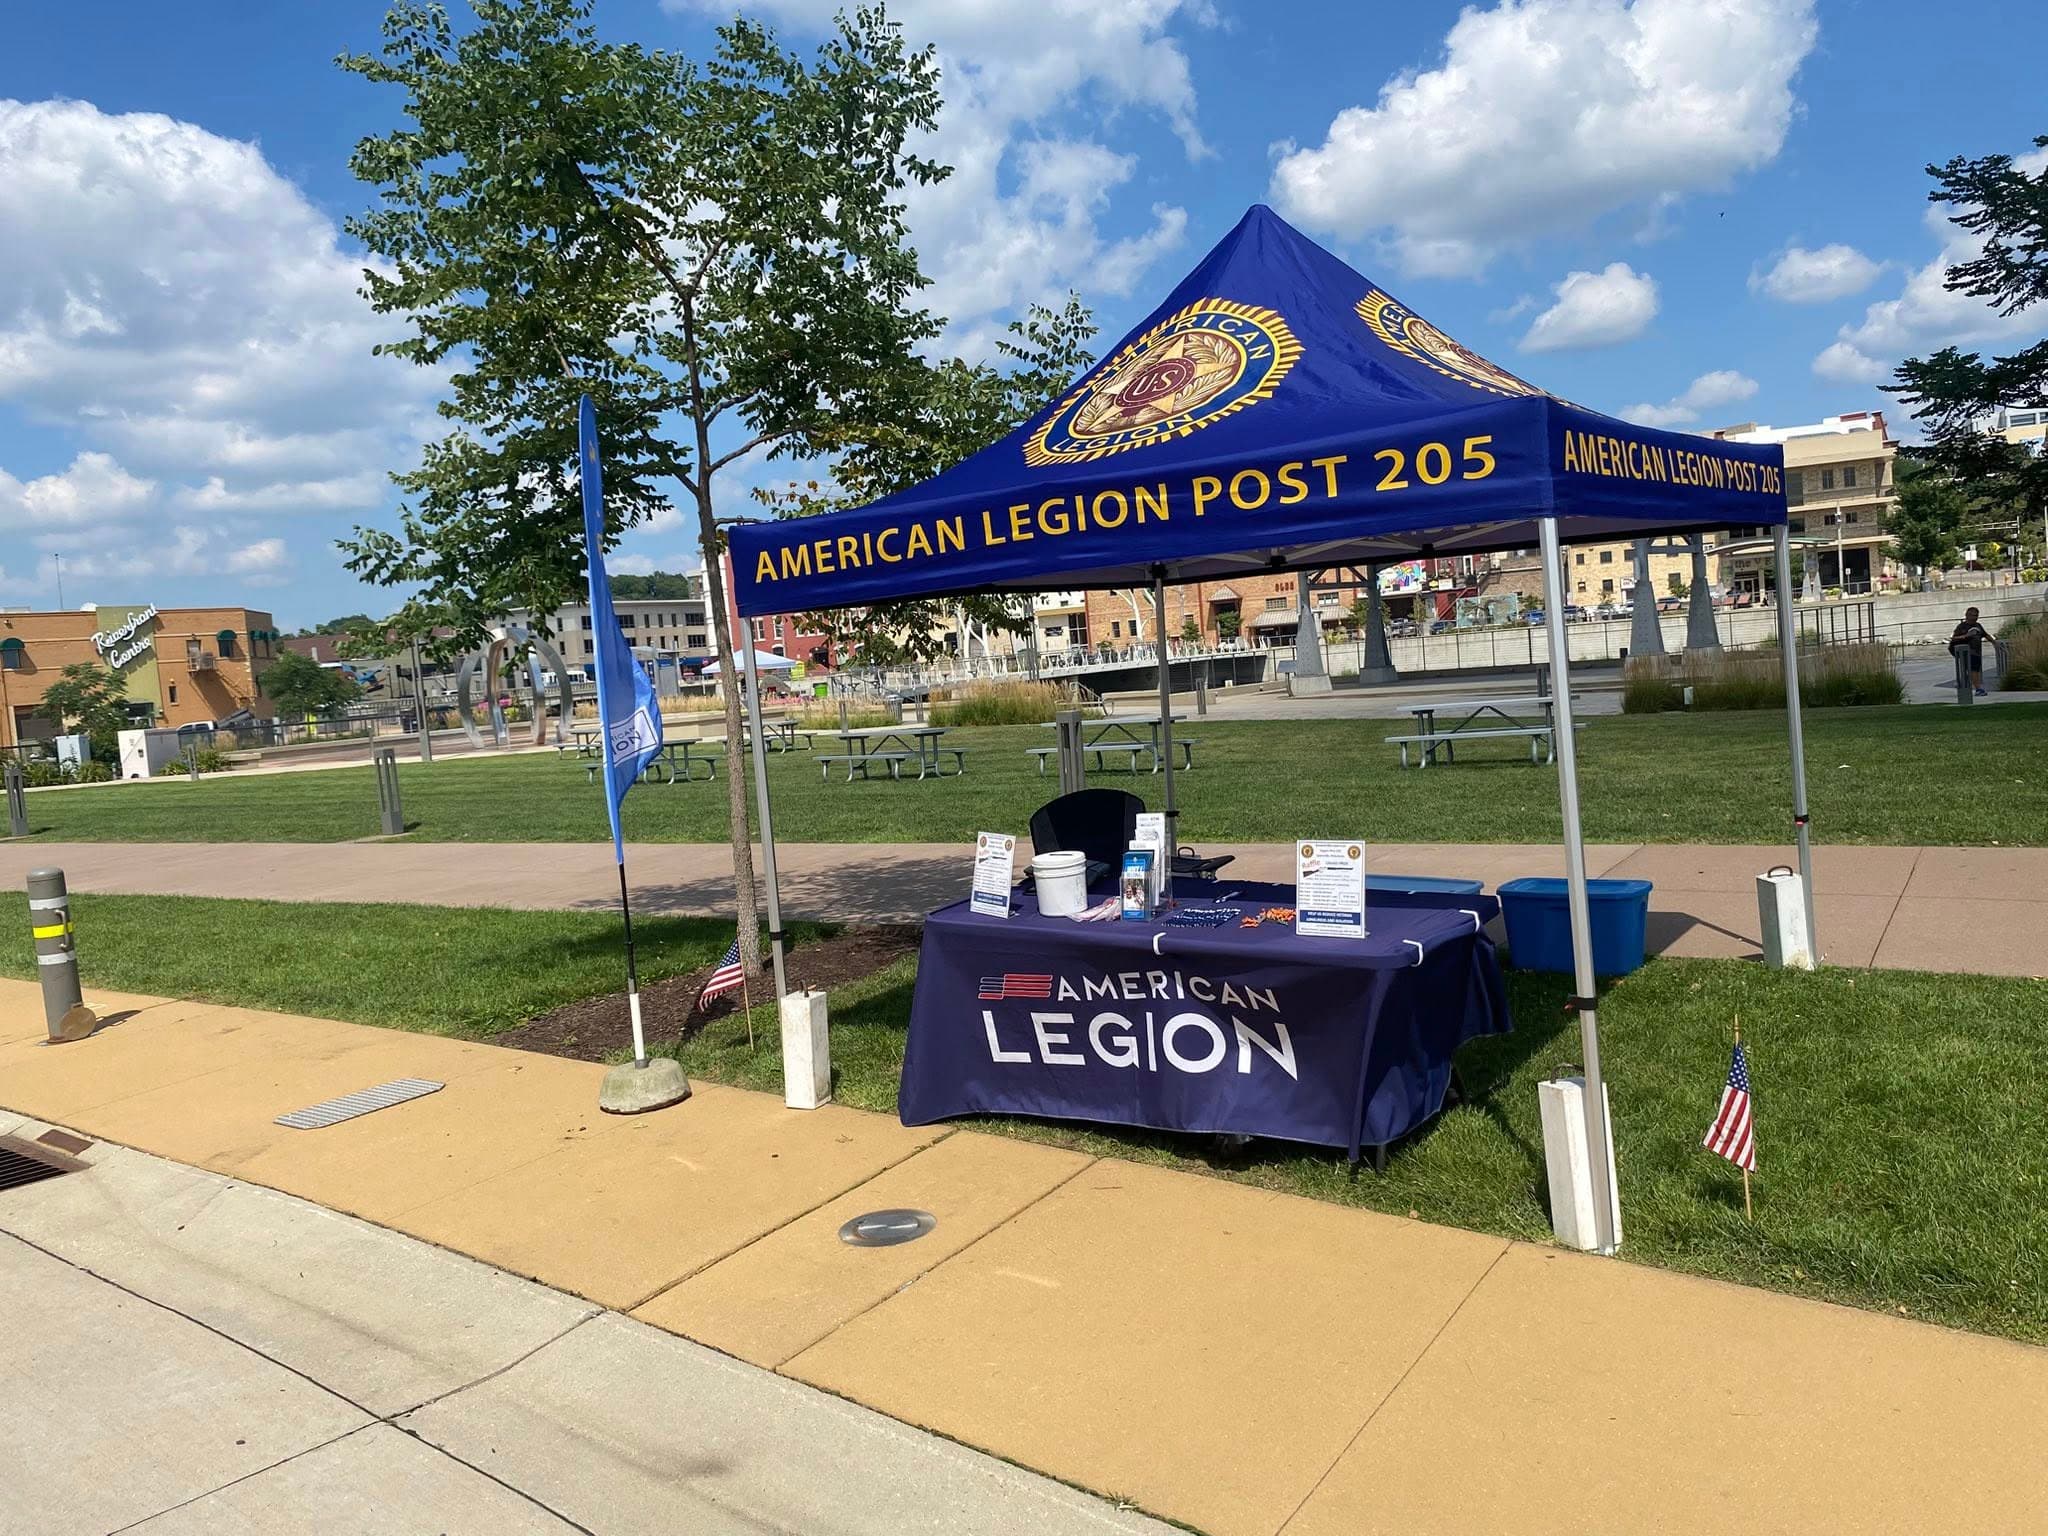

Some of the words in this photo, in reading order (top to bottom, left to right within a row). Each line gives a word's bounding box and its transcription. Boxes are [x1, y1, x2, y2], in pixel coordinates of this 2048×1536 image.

[1052, 414, 1193, 453] LEGION
[1564, 430, 1667, 482] AMERICAN
[1668, 448, 1724, 489] LEGION
[1725, 459, 1757, 492] POST
[1759, 465, 1781, 495] 205
[755, 516, 966, 583] AMERICAN
[982, 483, 1170, 546] LEGION
[1191, 455, 1348, 516] POST
[1373, 435, 1496, 492] 205
[90, 602, 159, 655] Riverfront
[110, 638, 152, 669] Centre
[1057, 970, 1280, 1013] AMERICAN
[982, 1010, 1298, 1081] LEGION
